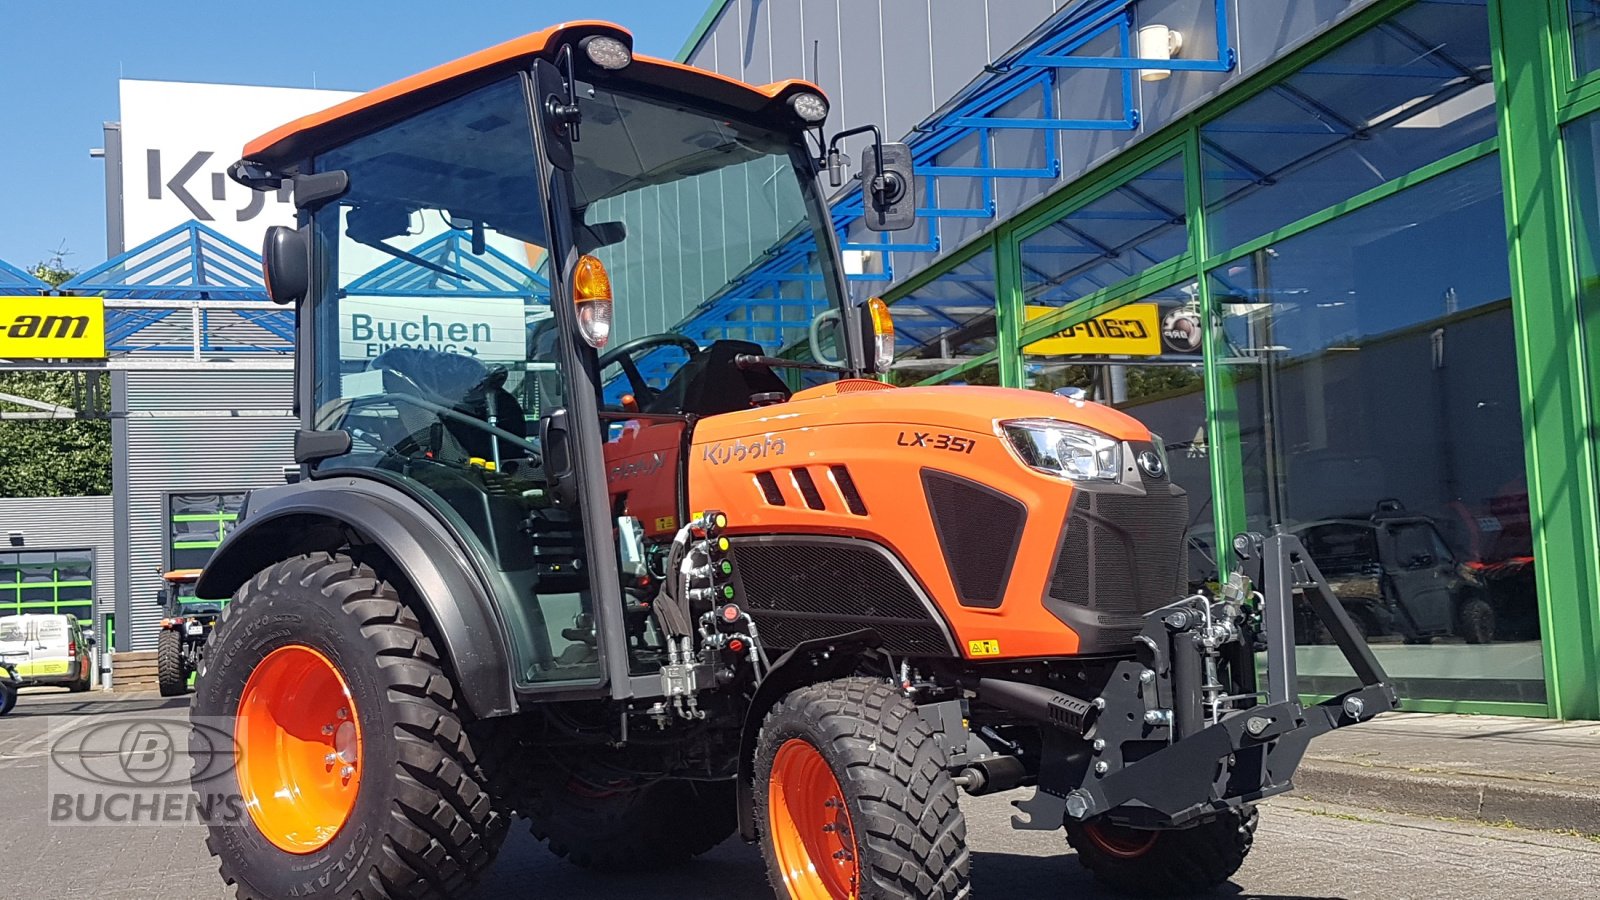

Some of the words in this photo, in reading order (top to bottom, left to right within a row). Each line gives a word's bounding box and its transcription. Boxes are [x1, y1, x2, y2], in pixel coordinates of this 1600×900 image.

[352, 313, 491, 342] Buchen
[703, 436, 786, 466] Kubota
[897, 432, 976, 454] LX-351
